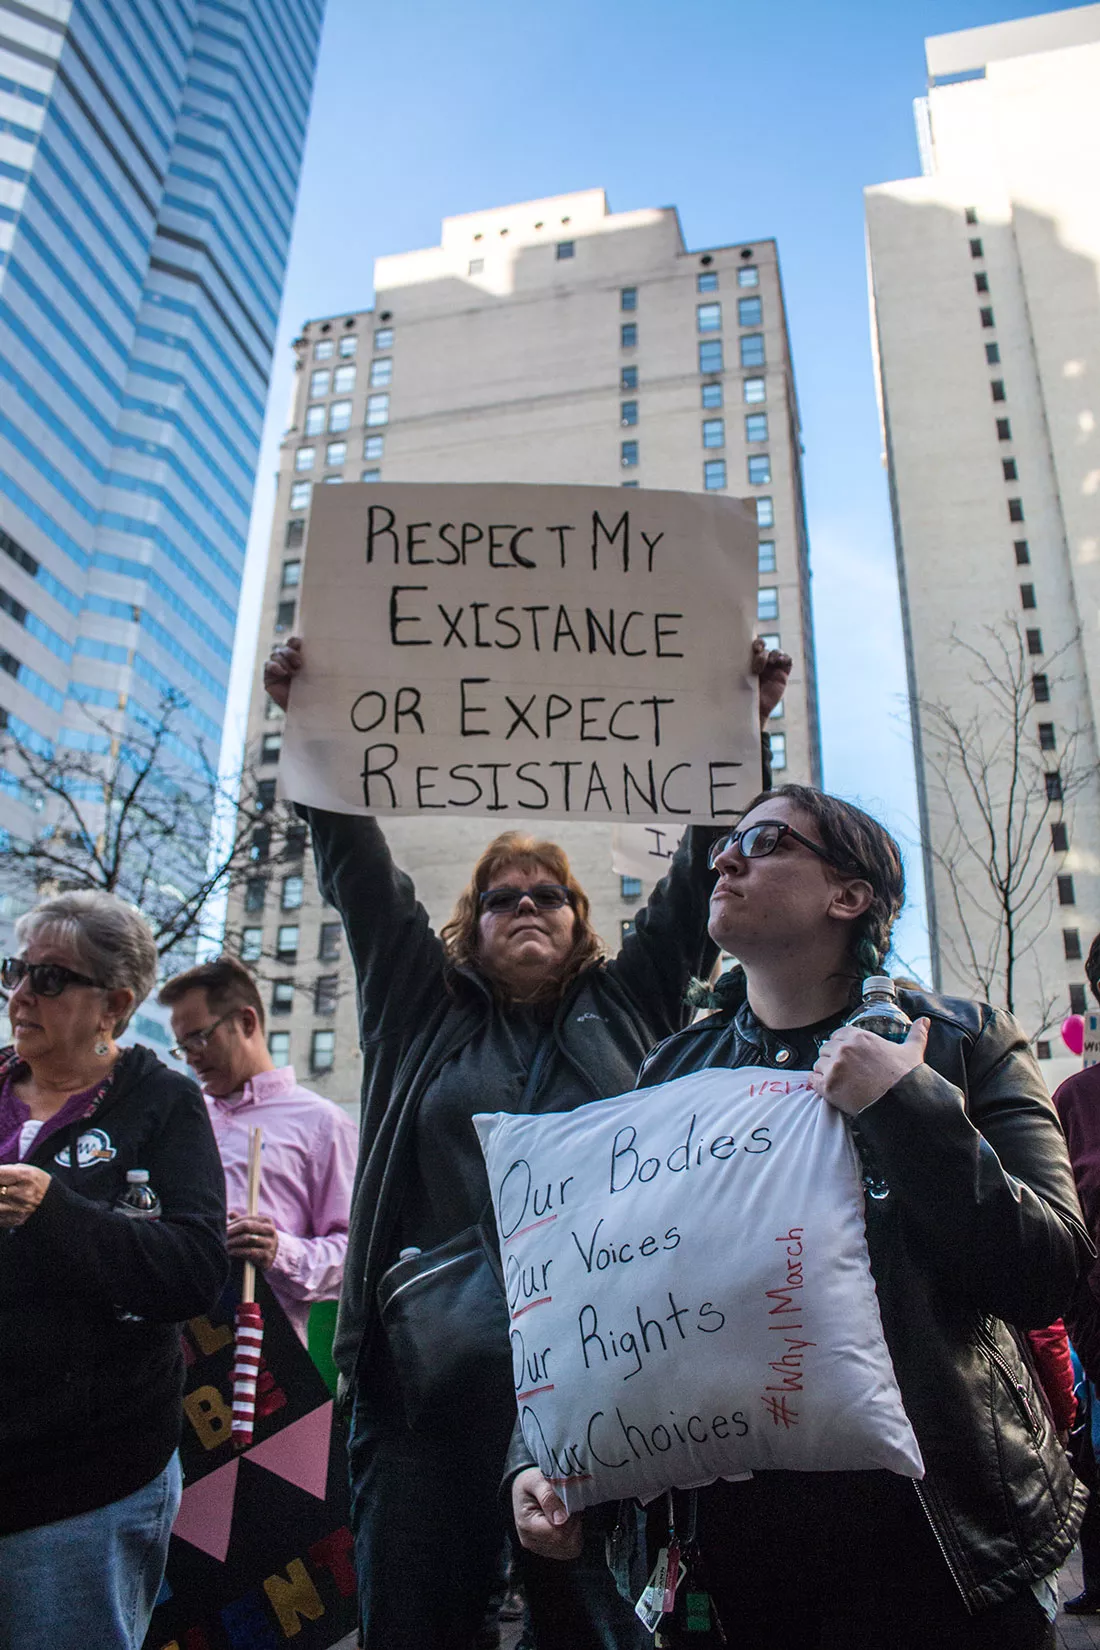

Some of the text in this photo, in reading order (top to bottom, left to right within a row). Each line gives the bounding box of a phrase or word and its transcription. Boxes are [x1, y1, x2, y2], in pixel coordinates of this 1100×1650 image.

[367, 504, 664, 572] RESPECT MY
[390, 585, 684, 658] EXISTANCE
[350, 677, 675, 747] OR EXPECT
[360, 743, 743, 819] RESISTANCE
[499, 1114, 772, 1240] Our Bodies
[506, 1218, 681, 1309] Our Voices
[765, 1227, 804, 1315] March
[578, 1292, 725, 1381] Rights
[760, 1338, 817, 1429] #Why
[521, 1405, 749, 1478] Our Choices
